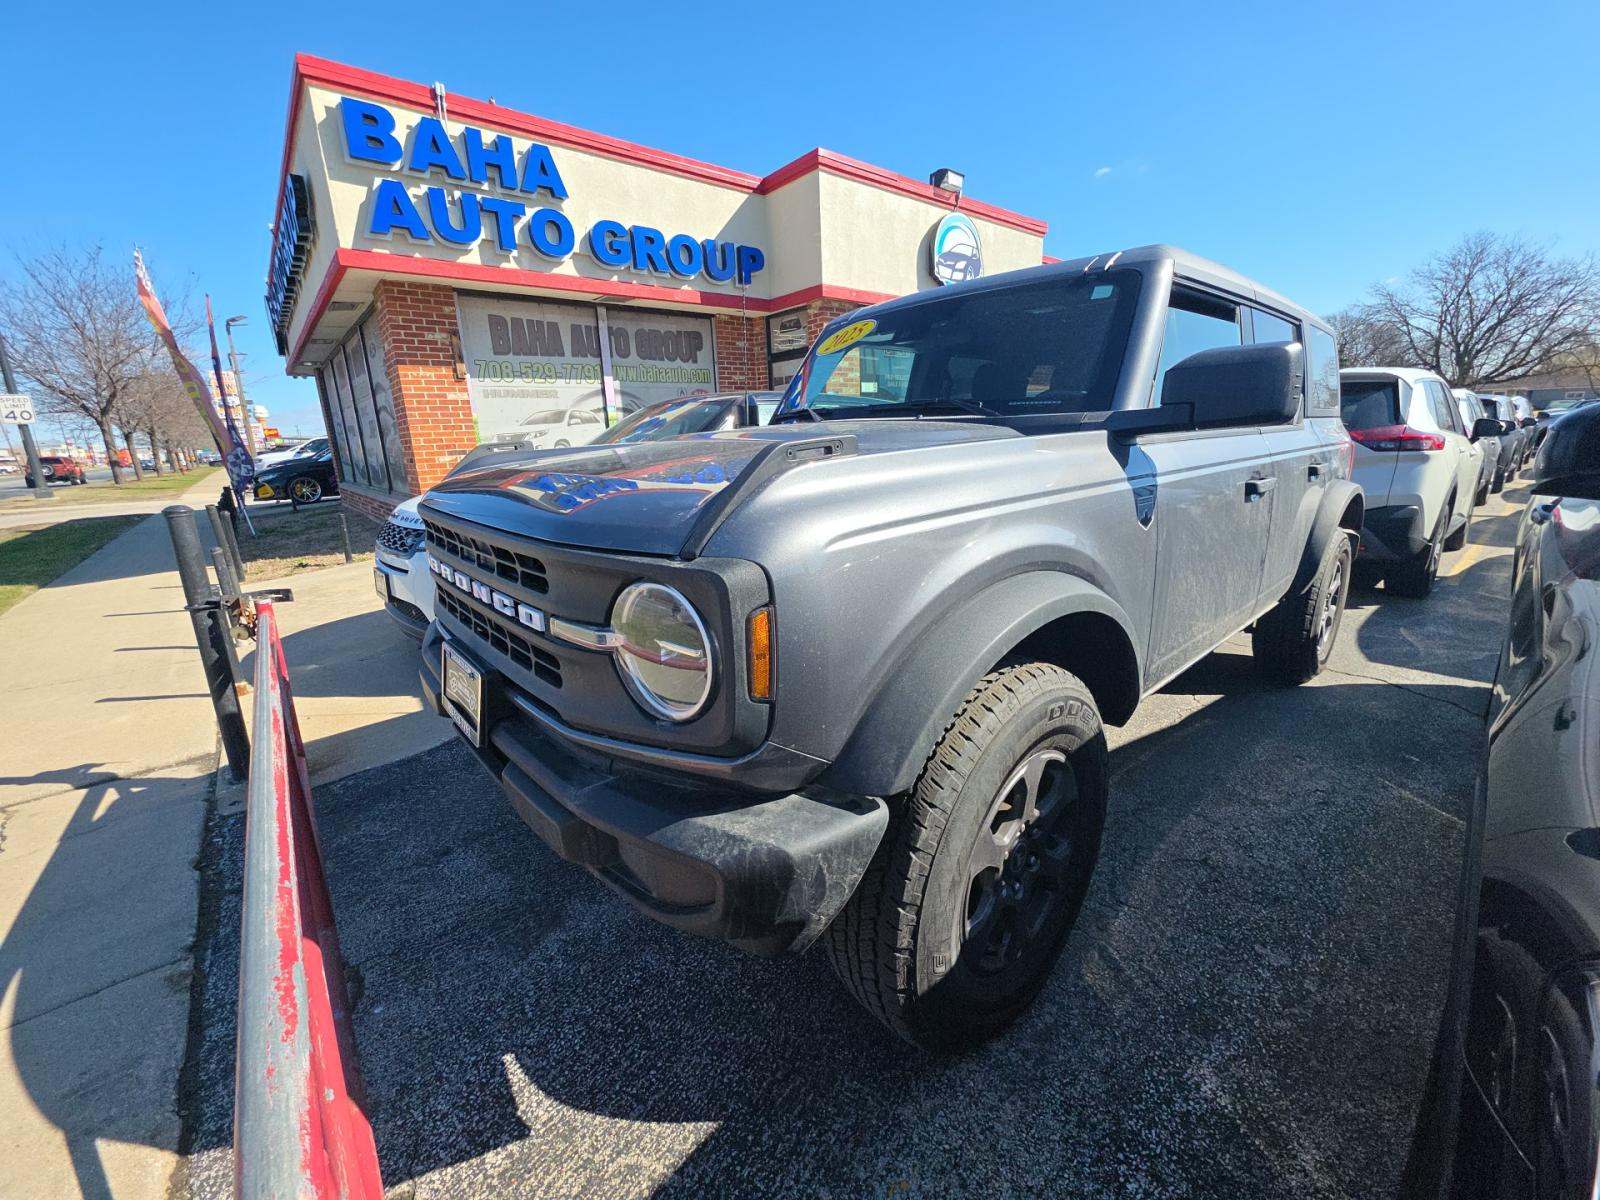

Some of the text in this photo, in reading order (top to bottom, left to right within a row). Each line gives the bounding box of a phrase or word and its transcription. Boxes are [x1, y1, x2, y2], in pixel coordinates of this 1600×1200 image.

[340, 96, 569, 200] BAHA
[371, 179, 765, 286] AUTO GROUP
[488, 314, 704, 364] BAHA AUTO GROUP
[475, 359, 602, 385] 708-529-7791
[5, 410, 32, 421] 40
[428, 554, 546, 632] BRONCO
